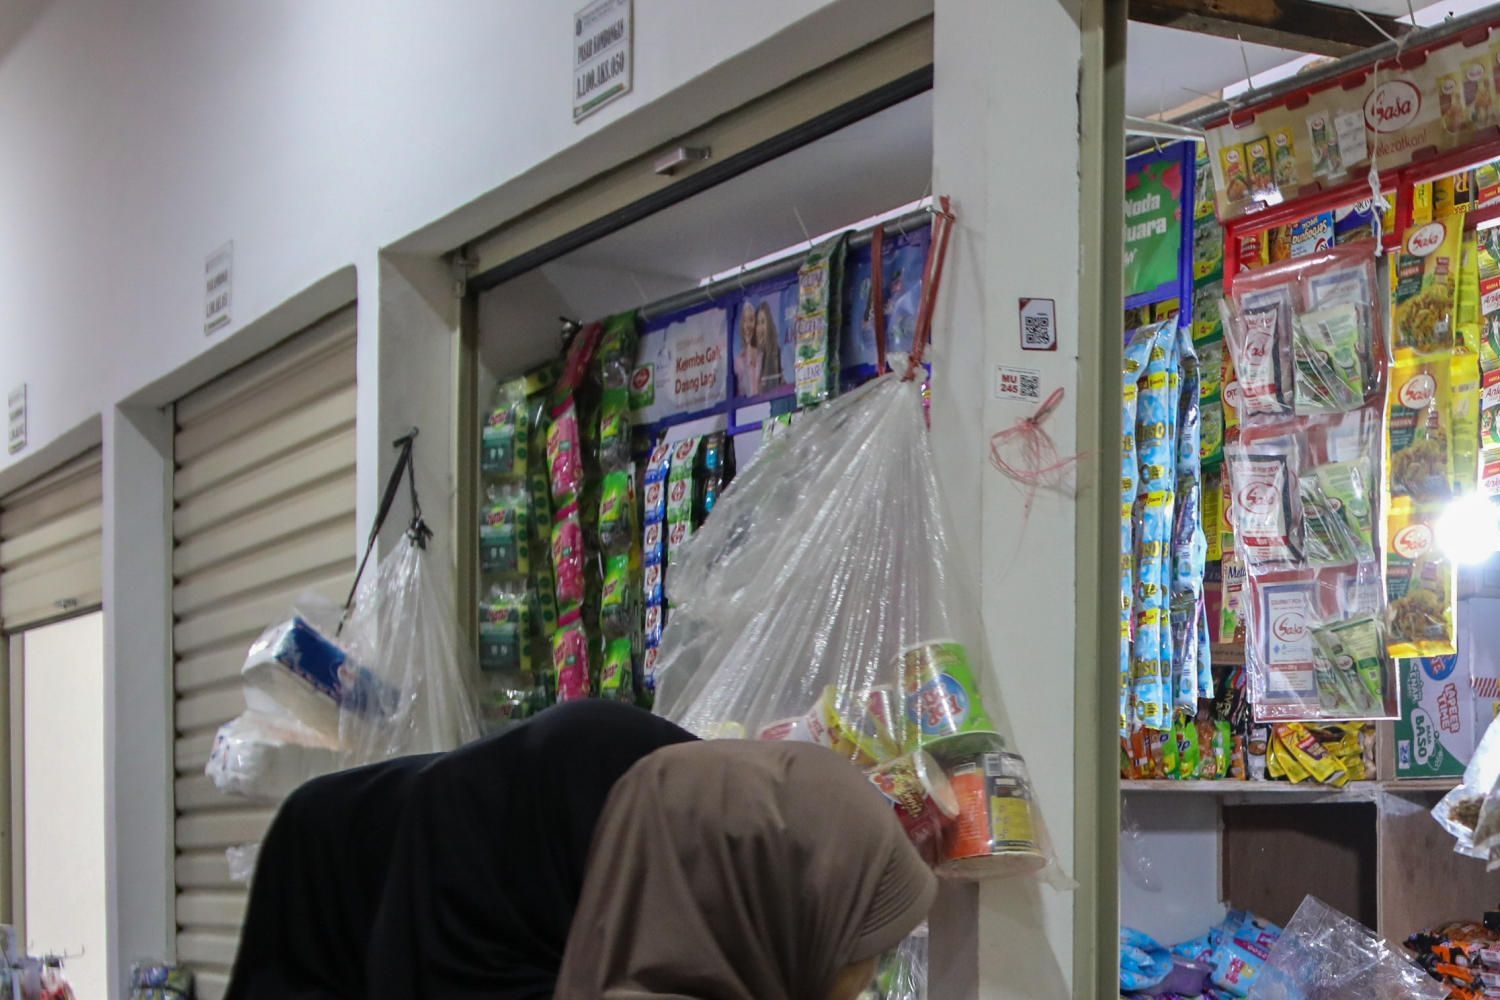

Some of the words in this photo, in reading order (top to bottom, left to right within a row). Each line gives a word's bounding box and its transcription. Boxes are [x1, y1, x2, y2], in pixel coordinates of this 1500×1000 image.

[1128, 217, 1167, 242] uara
[1002, 374, 1017, 383] MU
[1415, 715, 1428, 758] BASO
